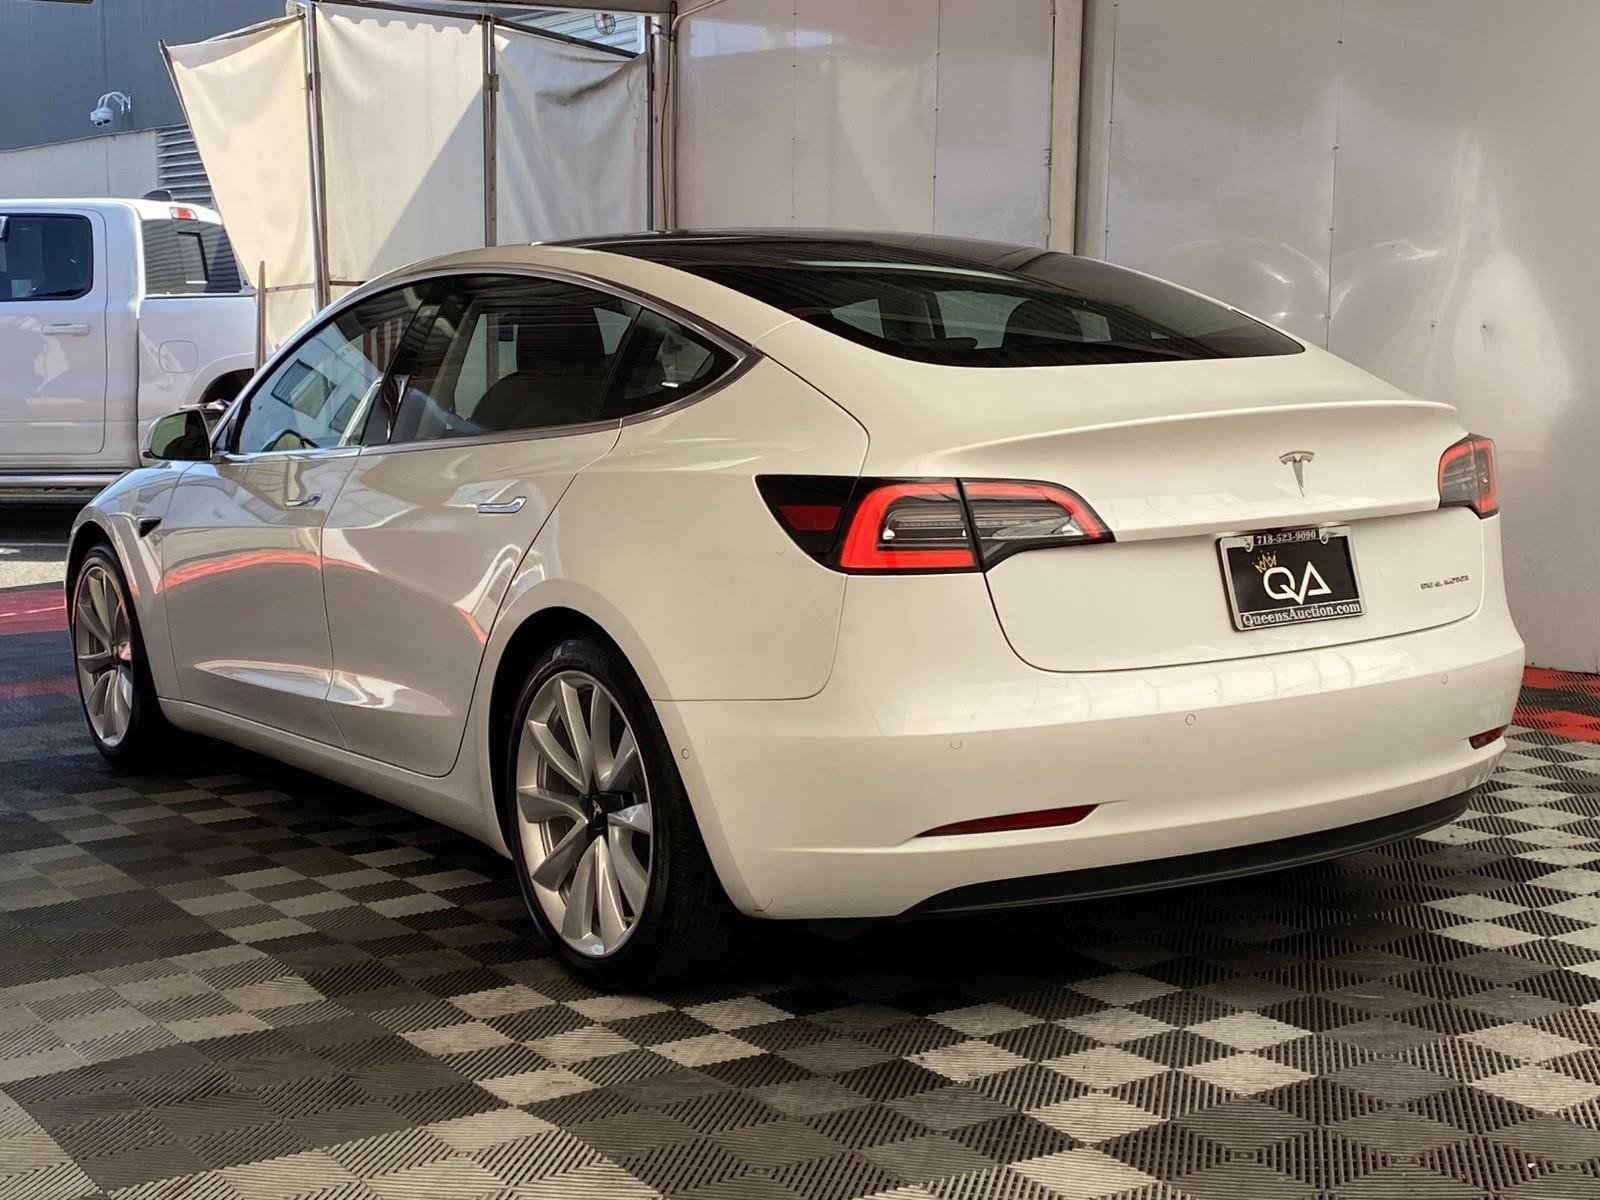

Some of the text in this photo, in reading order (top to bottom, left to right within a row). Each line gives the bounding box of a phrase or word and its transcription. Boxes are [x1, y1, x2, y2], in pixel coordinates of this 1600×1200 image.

[1257, 531, 1316, 545] 718-523-9090
[1263, 561, 1332, 605] QA
[1242, 603, 1360, 627] QueensAuction.com
